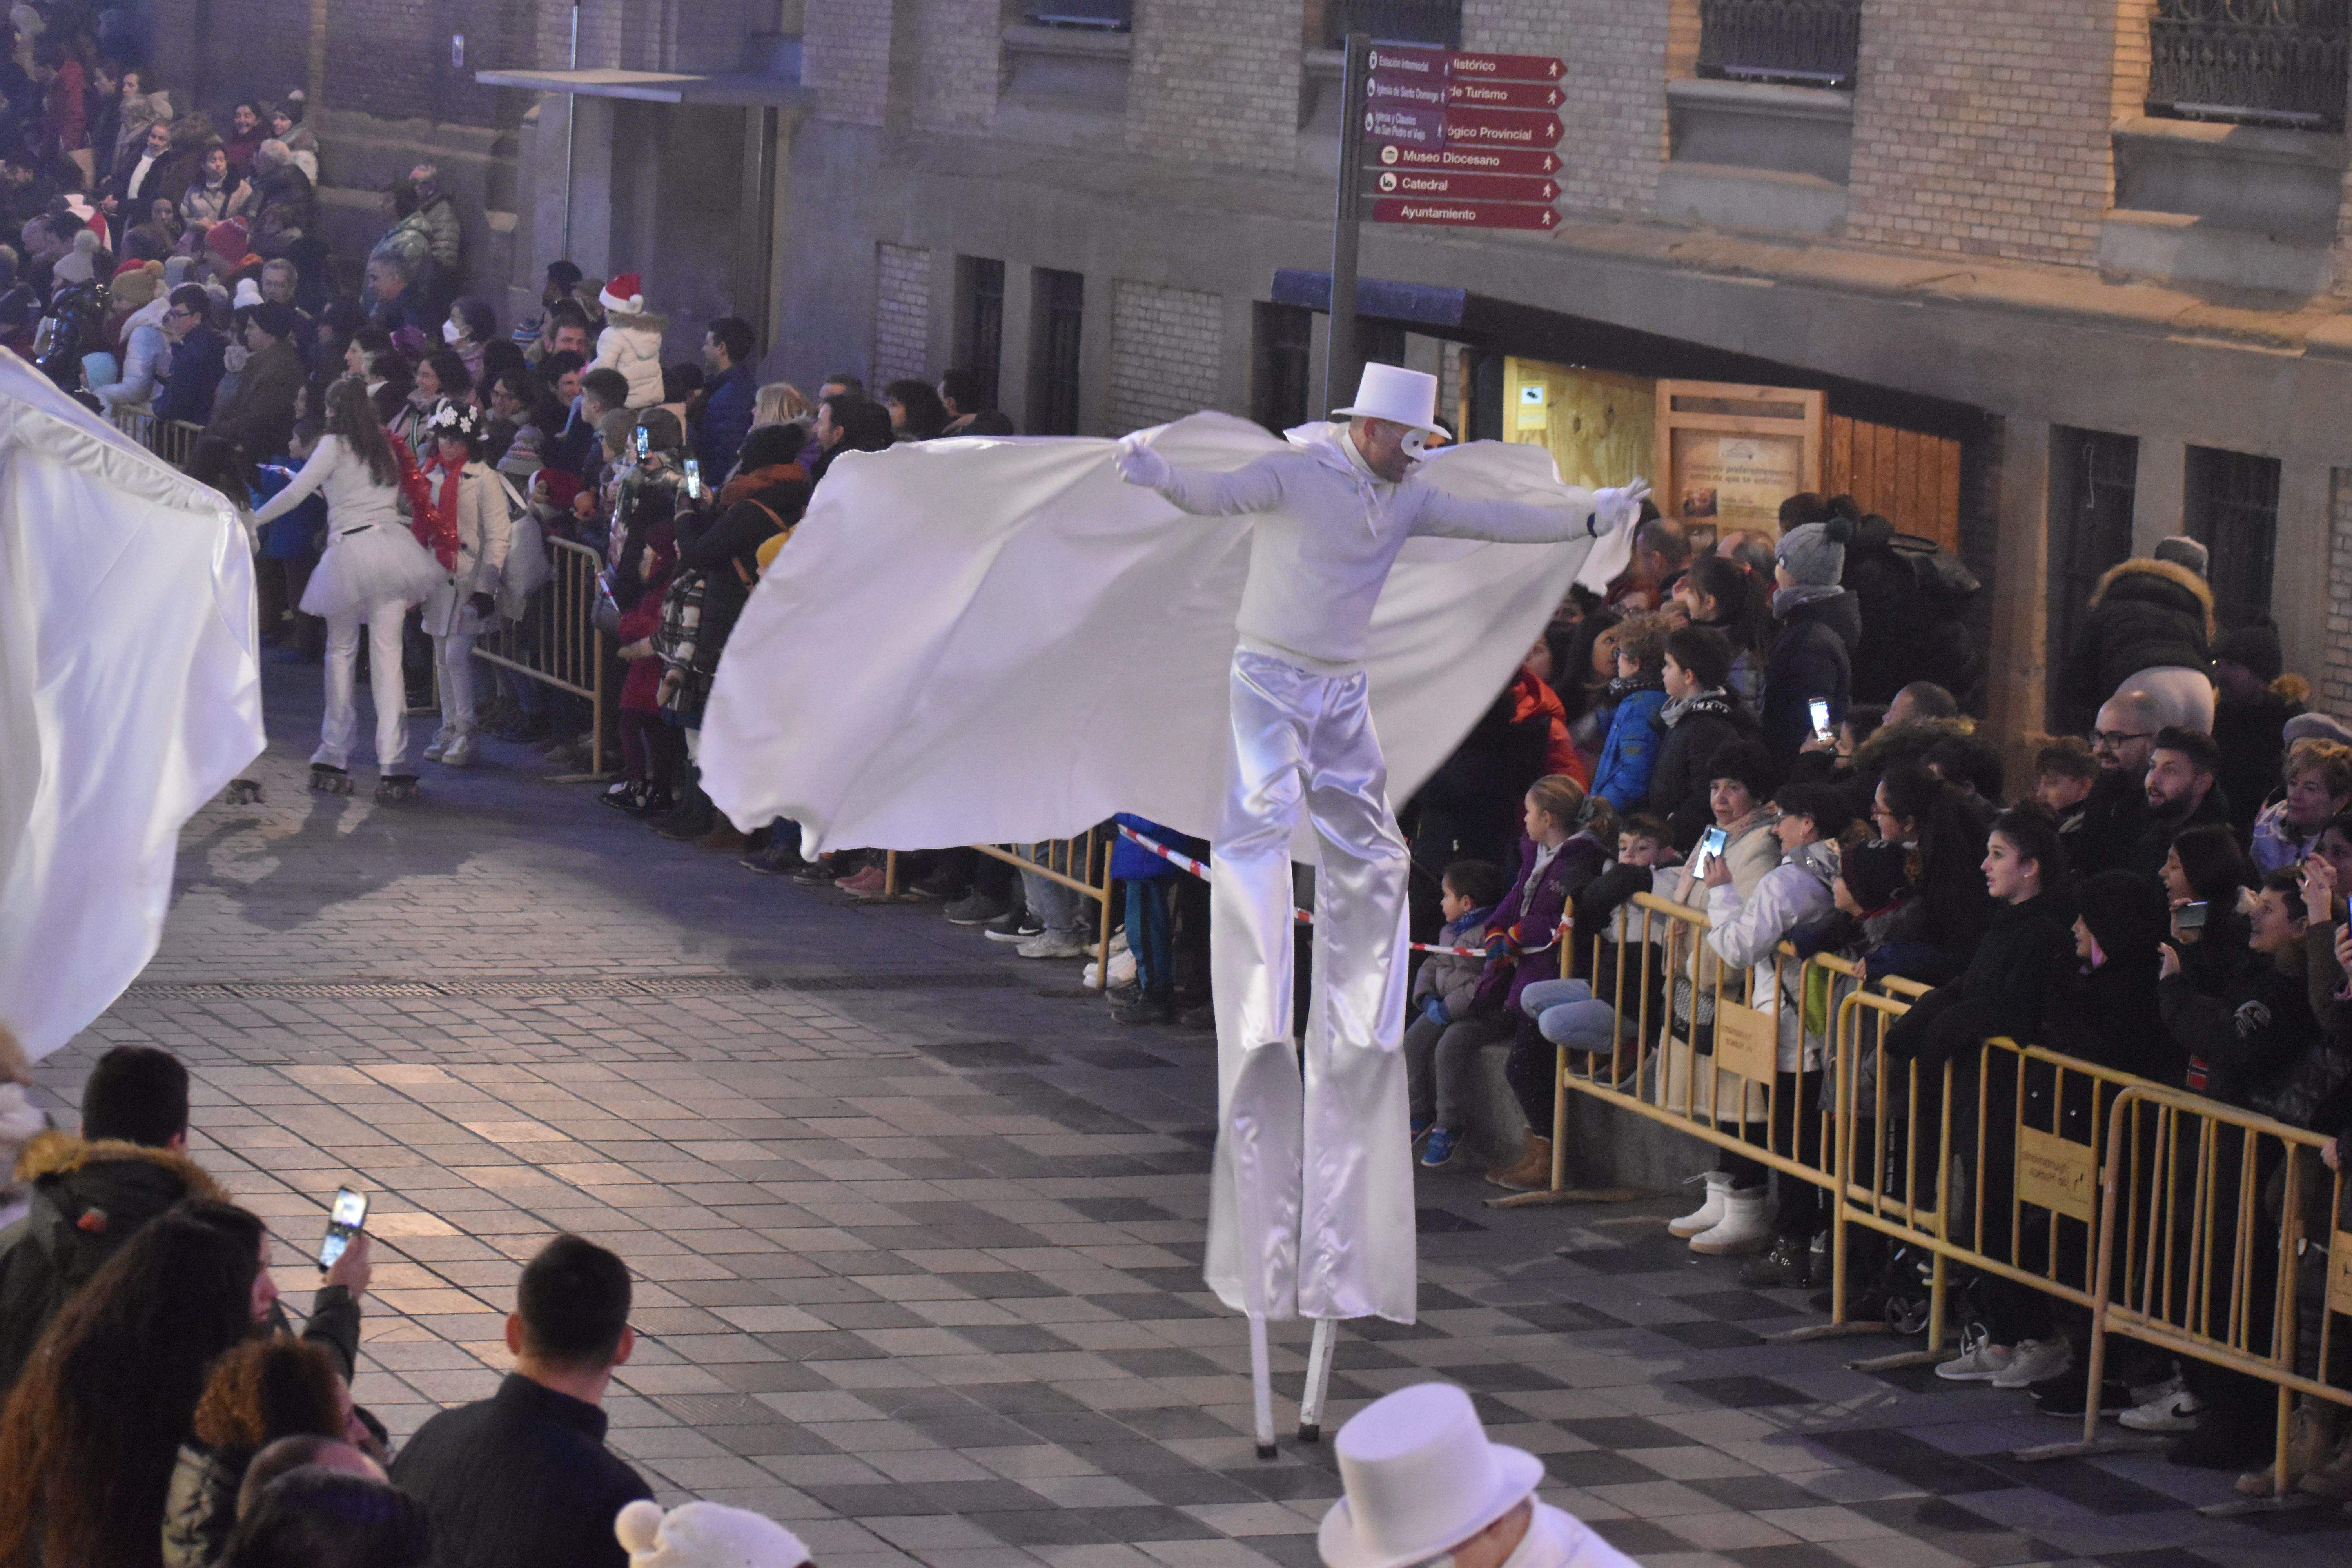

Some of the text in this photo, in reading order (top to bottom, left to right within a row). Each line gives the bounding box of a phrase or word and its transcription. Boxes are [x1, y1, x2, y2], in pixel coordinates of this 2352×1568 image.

[1465, 86, 1508, 100] Turismo
[1479, 127, 1532, 141] Provincial
[1403, 149, 1500, 167] Museo Diocesano
[1402, 177, 1448, 191] Catedral
[1401, 205, 1477, 221] Ayuntamiento
